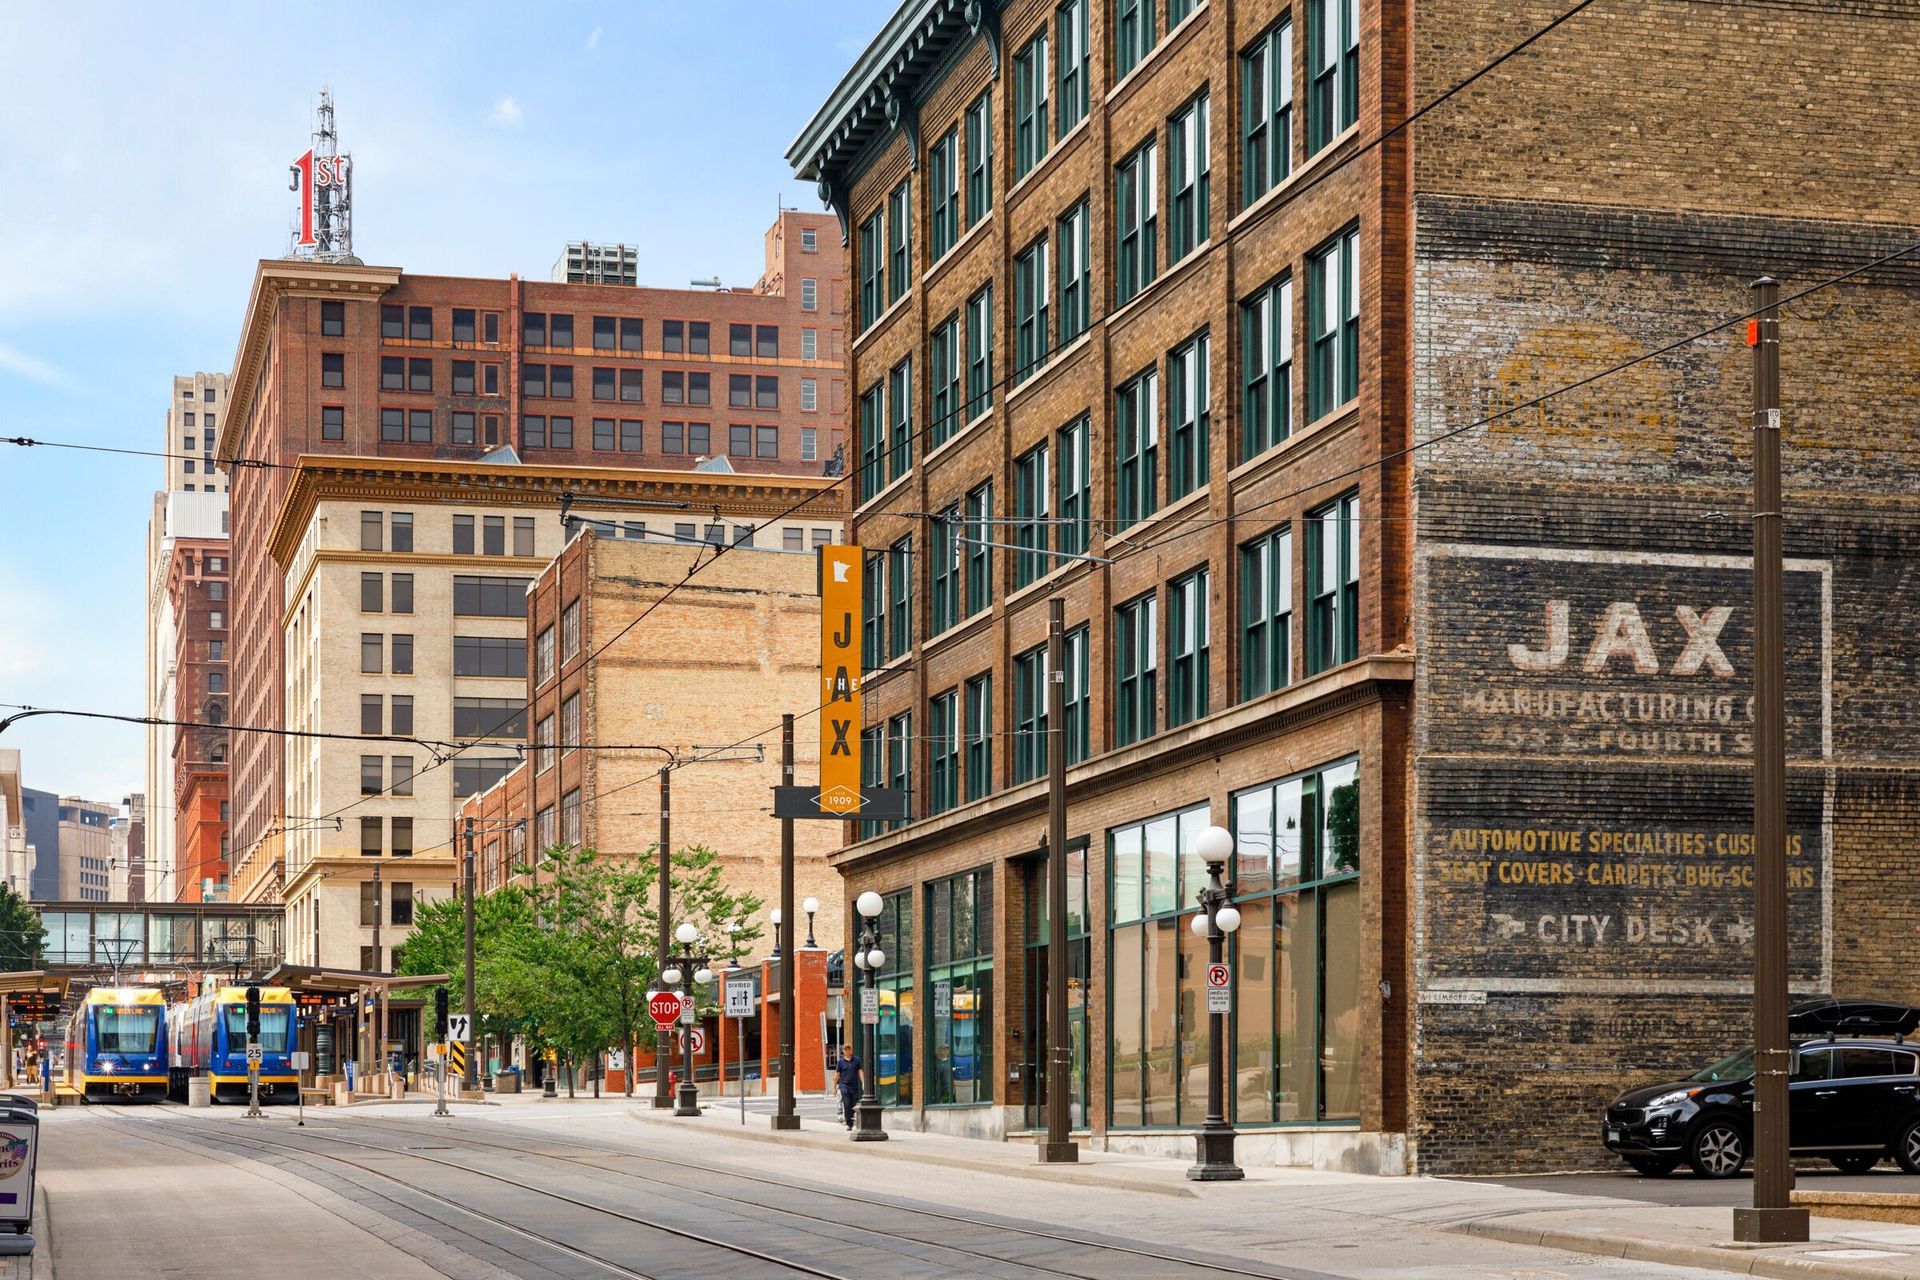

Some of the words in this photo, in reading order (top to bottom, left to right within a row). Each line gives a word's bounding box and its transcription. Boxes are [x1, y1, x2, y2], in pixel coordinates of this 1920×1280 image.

[294, 148, 346, 247] 1st
[1507, 598, 1736, 678] JAX
[825, 677, 858, 691] THE
[830, 612, 852, 756] JAX
[1462, 688, 1733, 724] MANUFACTURING
[1600, 730, 1721, 753] FOURTH
[829, 796, 852, 805] 1909
[1449, 828, 1582, 853] AUTOMOTIVE
[1588, 831, 1705, 856] SPECIALTIES
[1716, 833, 1802, 857] CUSS
[1439, 860, 1492, 883] SEAT
[1498, 862, 1575, 885] COVERS
[1587, 862, 1675, 886] CARPETS
[1537, 912, 1611, 944] CITY
[1626, 914, 1716, 945] DESK
[651, 1001, 679, 1015] STOP
[248, 1049, 261, 1058] 25
